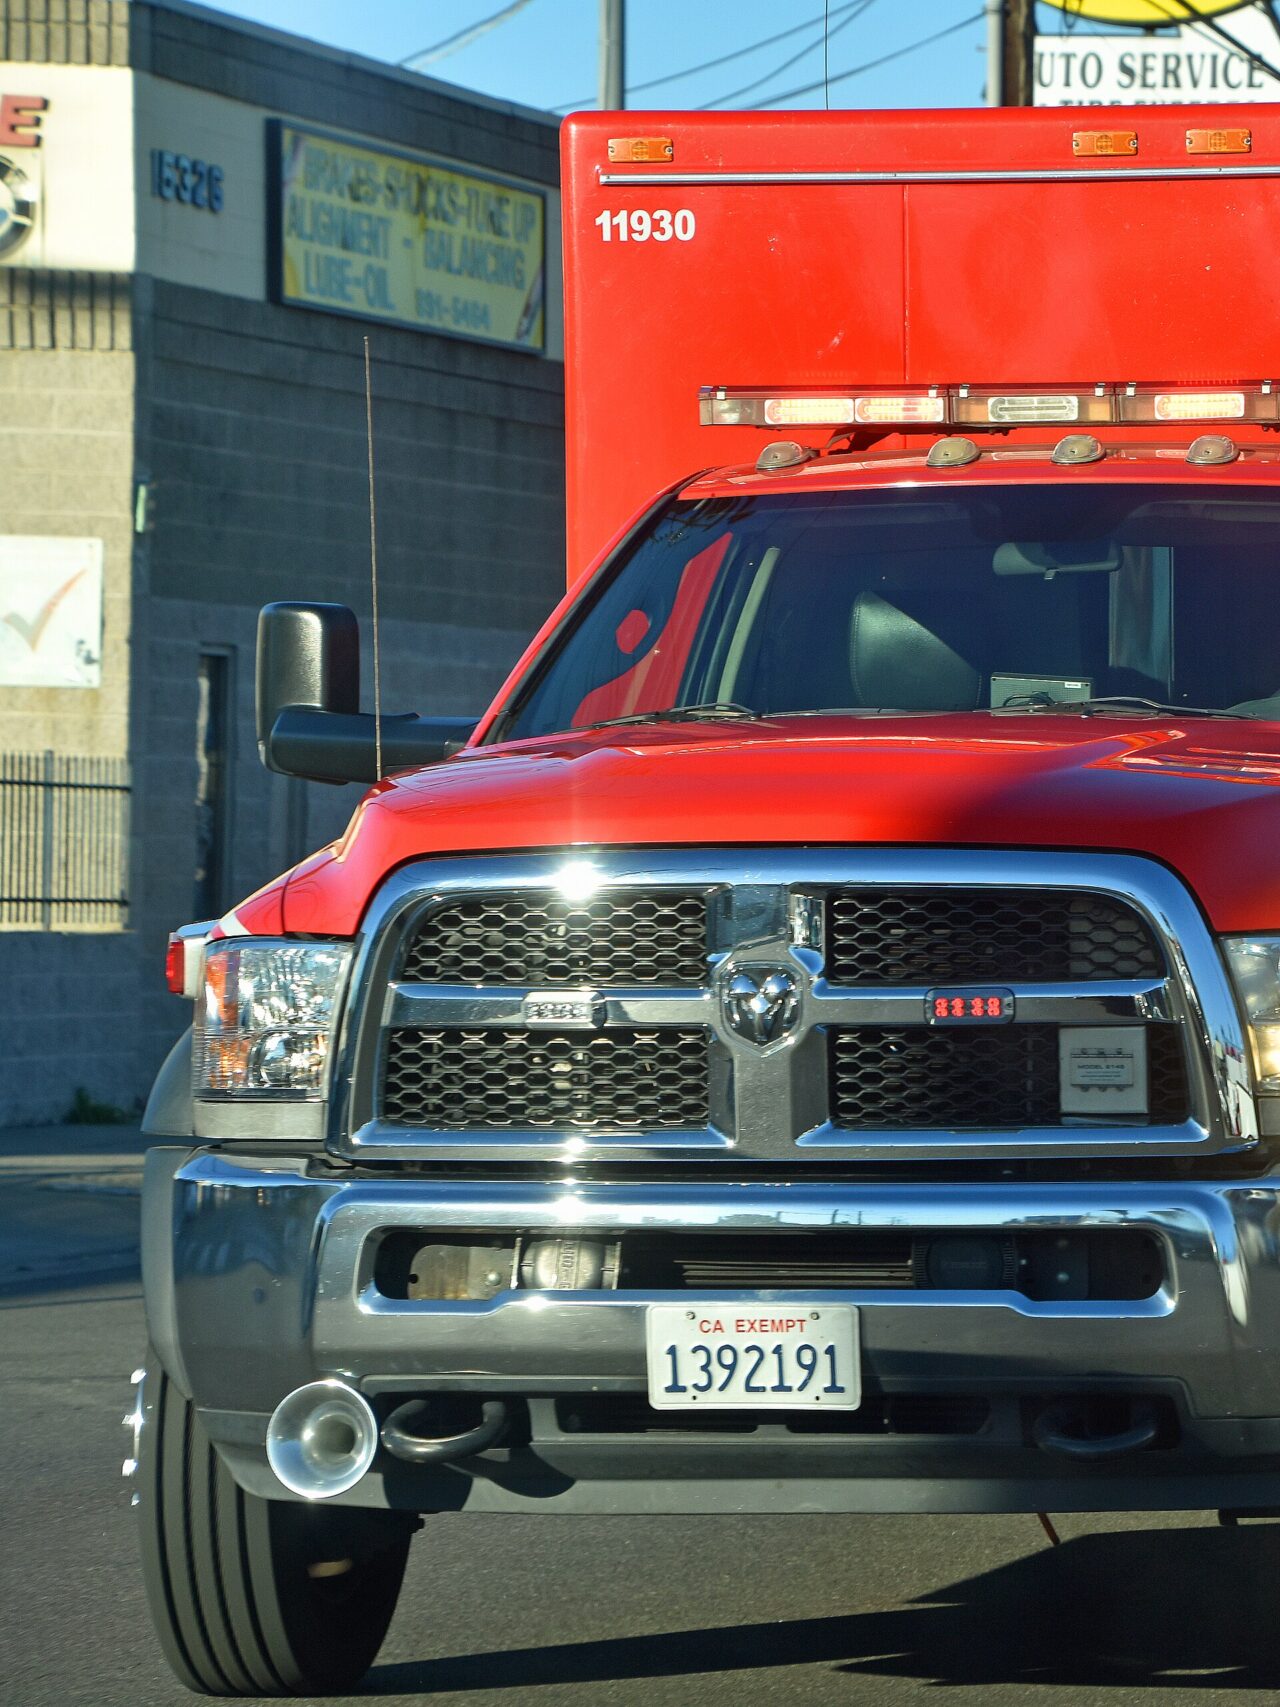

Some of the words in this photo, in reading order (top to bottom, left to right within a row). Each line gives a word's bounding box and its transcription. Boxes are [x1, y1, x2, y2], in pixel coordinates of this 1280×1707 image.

[1035, 52, 1103, 89] UTO
[1117, 52, 1264, 89] SERVICE
[0, 94, 49, 148] E
[286, 194, 392, 260] ALIGNMENT
[424, 228, 526, 290] BALANCING
[595, 209, 696, 241] 11930
[304, 250, 396, 311] LUBE-OIL
[700, 1319, 725, 1334] CA
[735, 1319, 808, 1334] EXEMPT
[664, 1344, 845, 1394] 1392191
